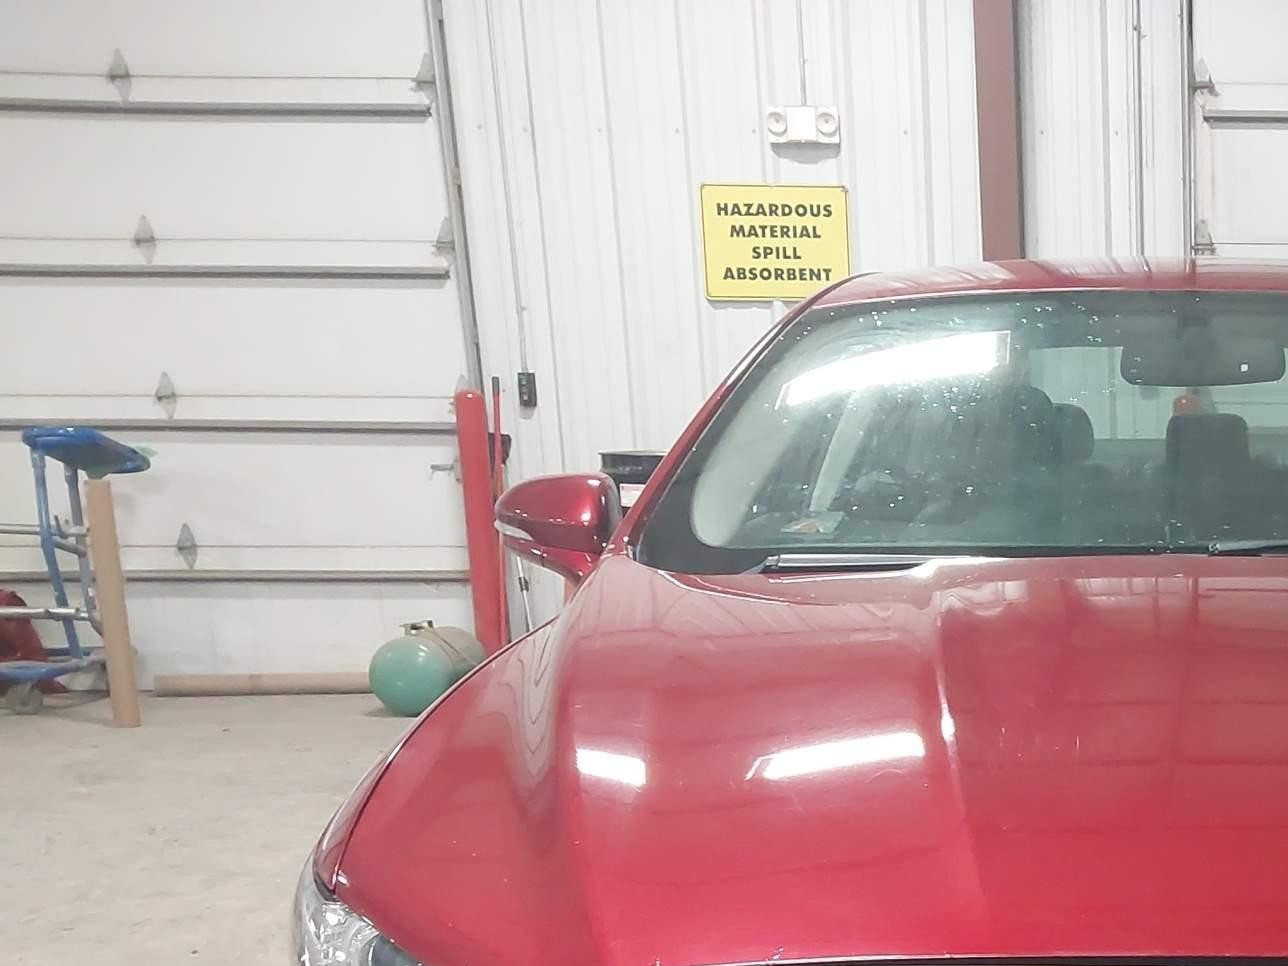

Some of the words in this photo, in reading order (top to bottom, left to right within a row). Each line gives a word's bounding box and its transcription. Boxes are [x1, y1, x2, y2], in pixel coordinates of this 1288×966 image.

[716, 203, 833, 218] HAZARDOUS
[729, 224, 822, 239] MATERIAL
[751, 246, 802, 260] SPILL
[722, 267, 833, 282] ABSORBENT
